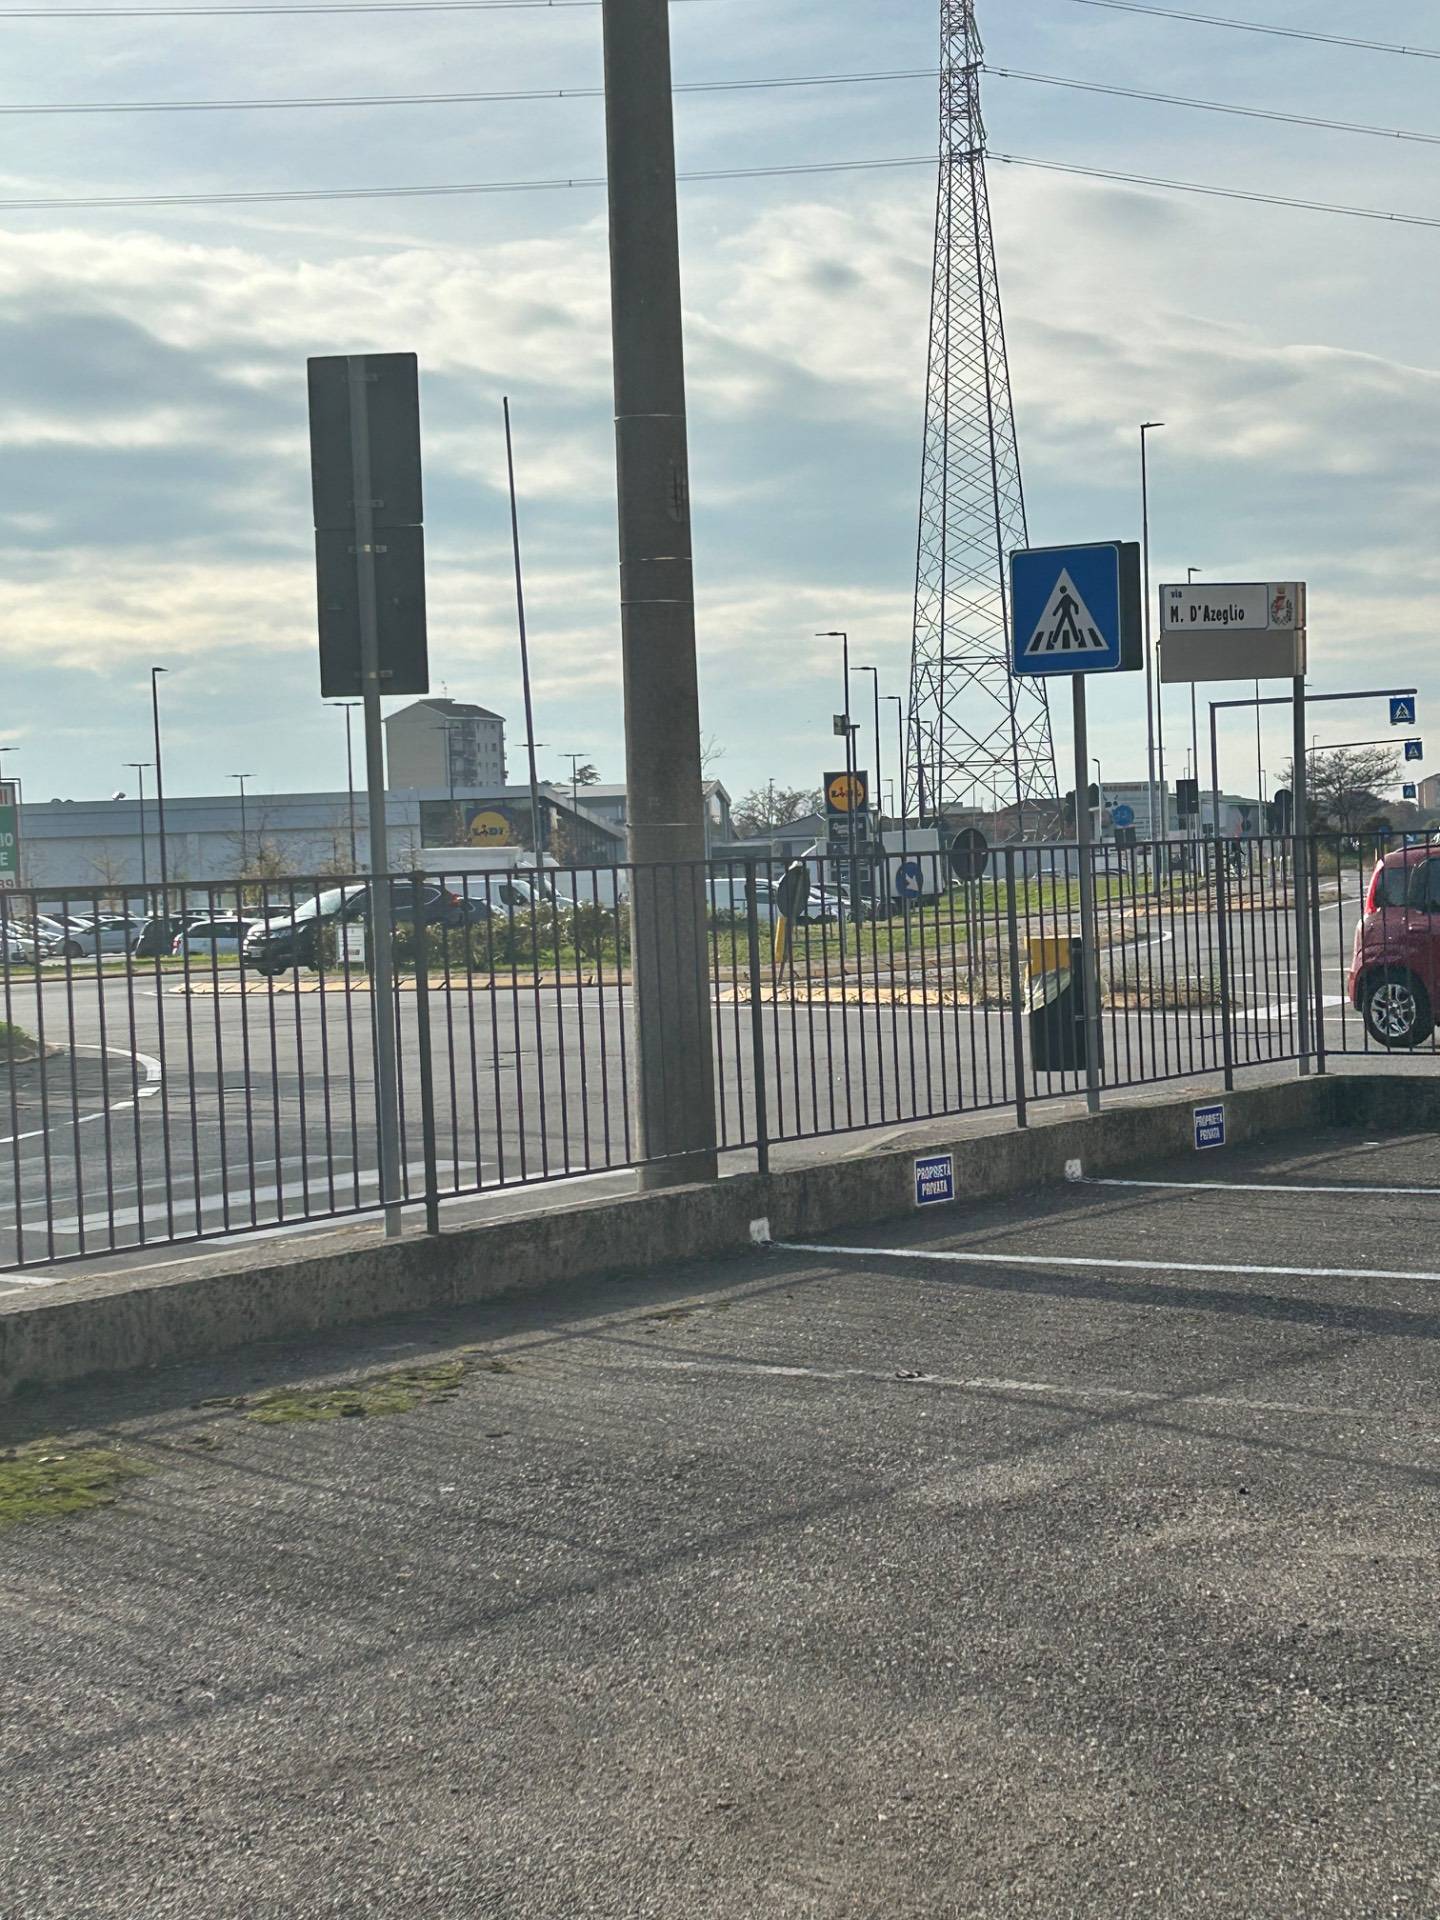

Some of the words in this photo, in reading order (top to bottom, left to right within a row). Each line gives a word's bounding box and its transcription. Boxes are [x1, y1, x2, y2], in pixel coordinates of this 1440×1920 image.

[1170, 589, 1182, 598] via
[1170, 605, 1184, 623] M.
[1190, 604, 1245, 625] D'Azeglio
